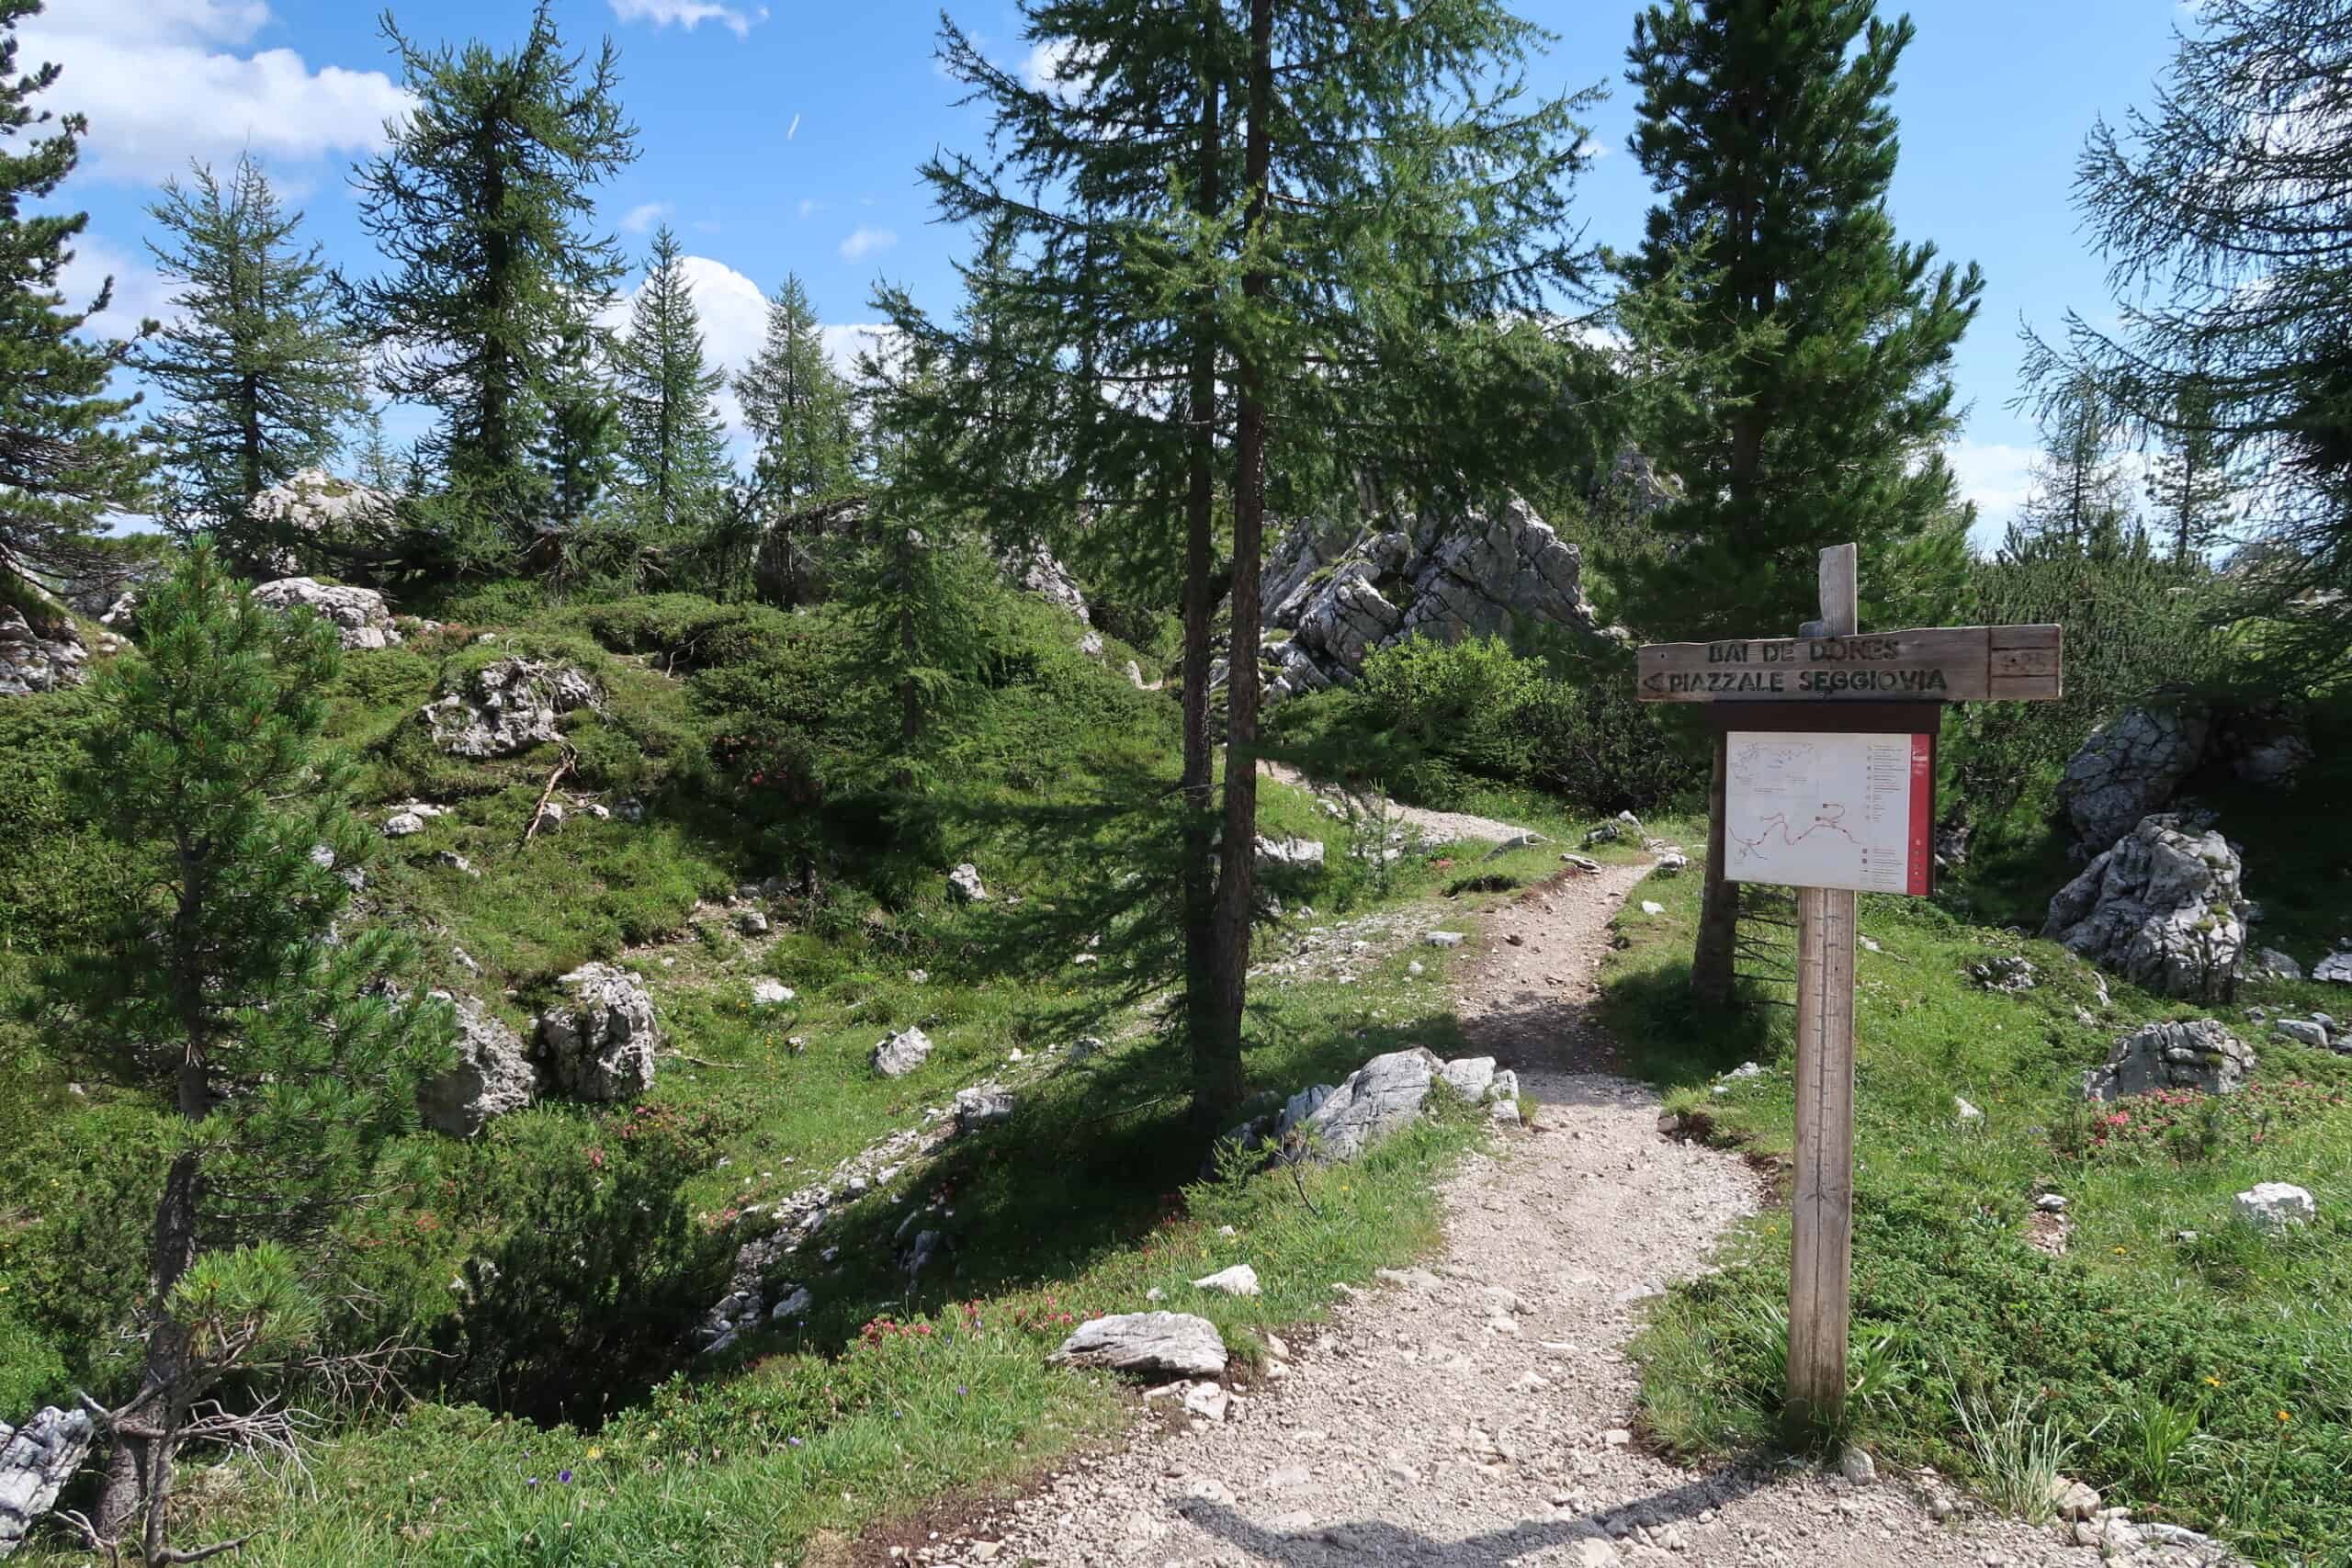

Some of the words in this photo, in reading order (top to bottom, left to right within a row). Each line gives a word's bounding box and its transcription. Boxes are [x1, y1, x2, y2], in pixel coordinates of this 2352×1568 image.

[1708, 644, 1749, 663] BAI
[1763, 642, 1794, 662] DE
[1668, 671, 1784, 693] PIAZZALE
[1799, 669, 1949, 692] SEGGIOVIA
